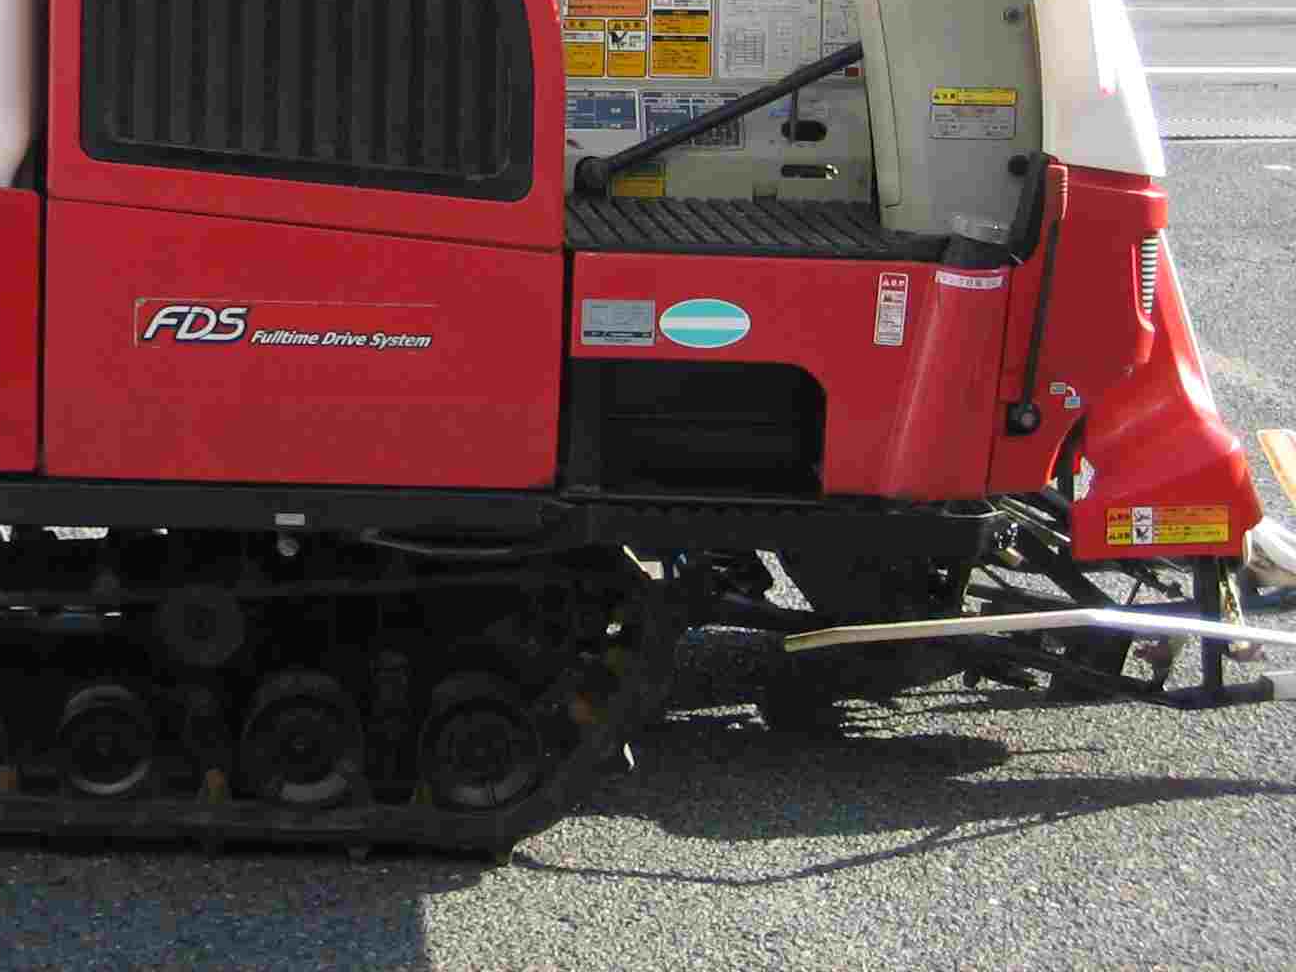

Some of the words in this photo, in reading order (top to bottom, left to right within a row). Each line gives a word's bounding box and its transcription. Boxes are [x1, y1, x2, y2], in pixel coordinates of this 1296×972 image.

[142, 304, 250, 343] FDS
[250, 329, 320, 347] Fulltime
[321, 330, 368, 348] Drive
[369, 331, 433, 349] System
